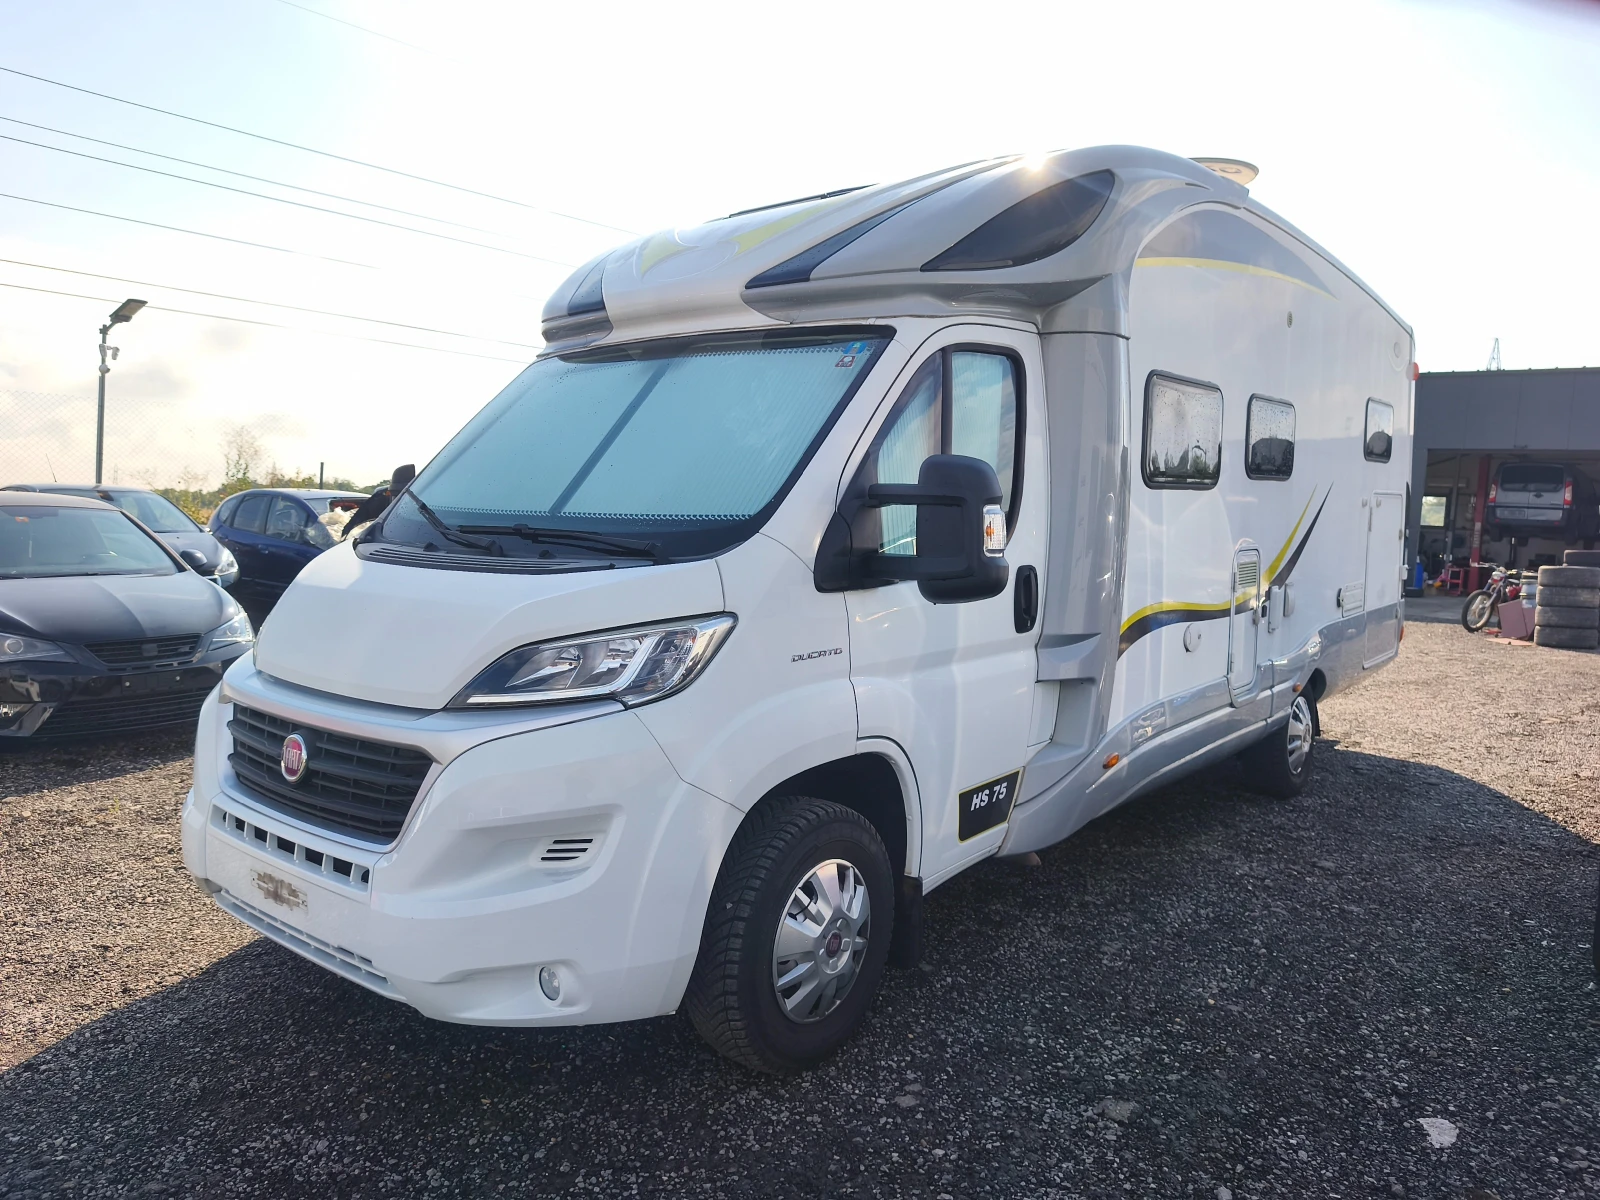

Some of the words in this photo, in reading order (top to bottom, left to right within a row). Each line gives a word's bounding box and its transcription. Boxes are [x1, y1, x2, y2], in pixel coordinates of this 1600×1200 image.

[791, 647, 843, 663] DUCATO
[285, 746, 301, 770] FIAT
[970, 789, 990, 812] HS
[992, 781, 1008, 803] 75
